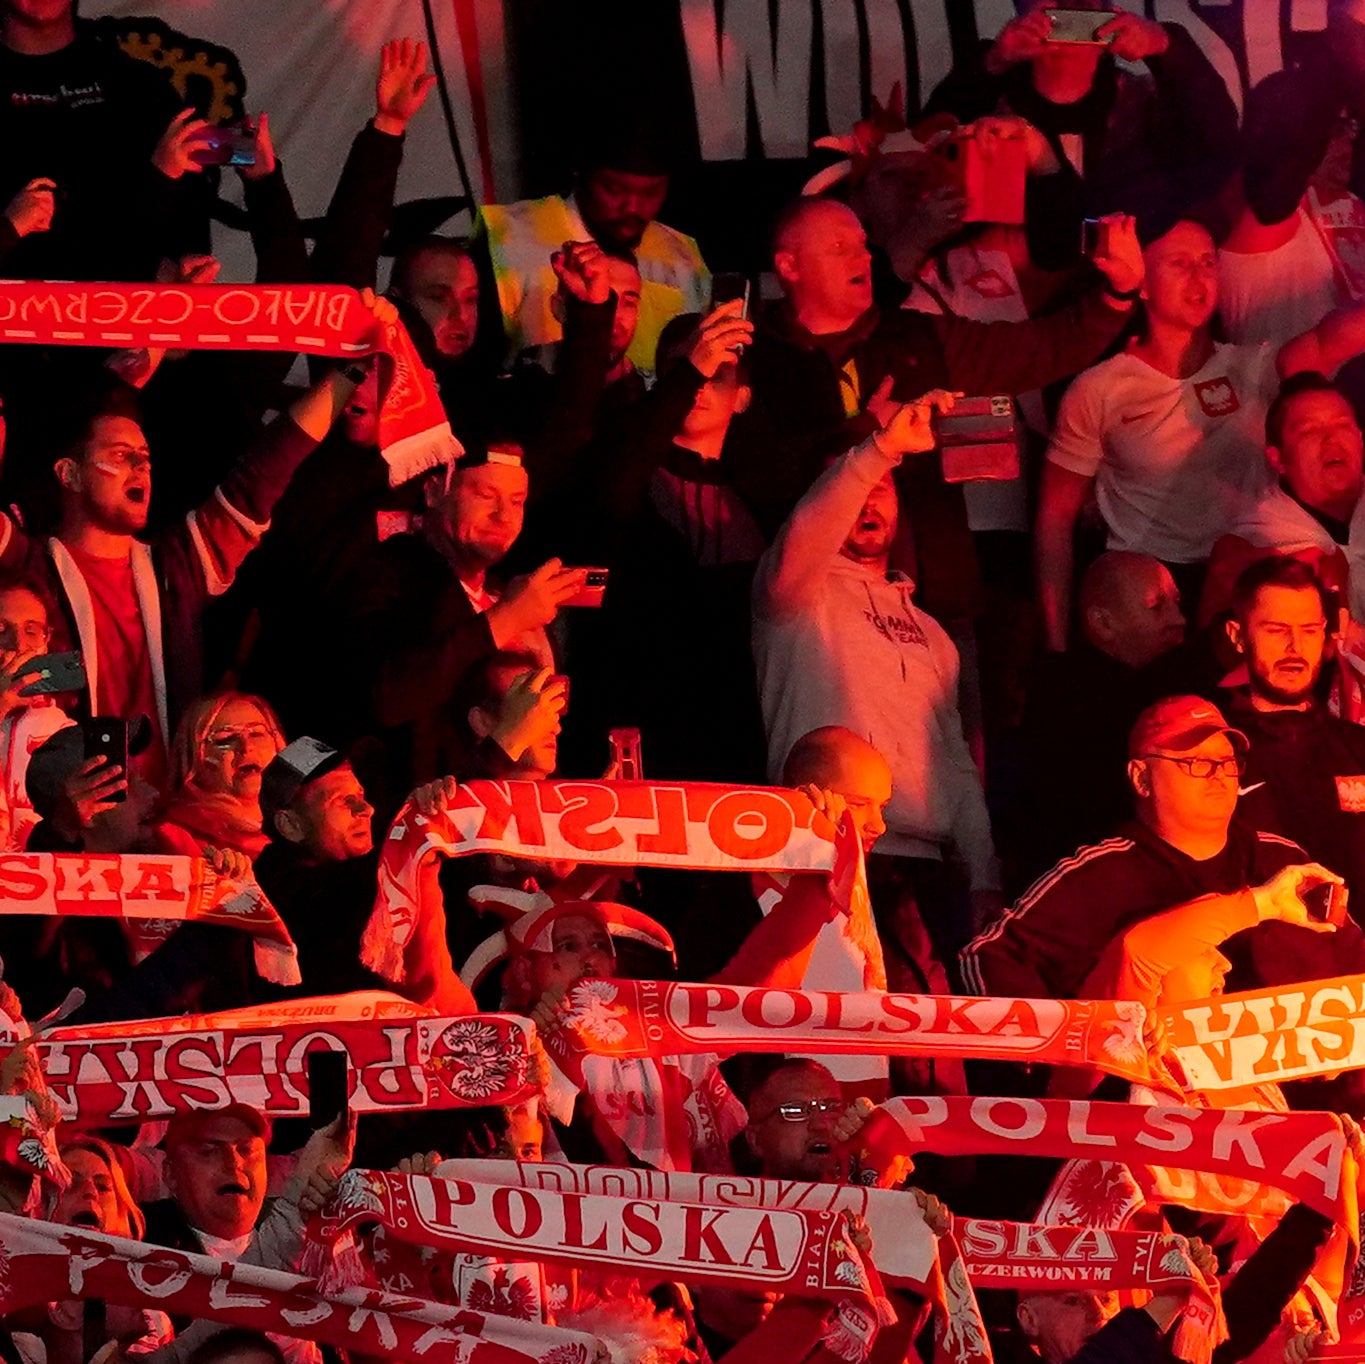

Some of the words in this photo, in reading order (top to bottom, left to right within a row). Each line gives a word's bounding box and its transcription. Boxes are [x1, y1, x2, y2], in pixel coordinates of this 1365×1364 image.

[0, 854, 186, 902] SKA
[641, 980, 662, 1043] BIAŁO
[681, 984, 1044, 1040] POLSKA
[888, 1097, 1345, 1201] POLSKA
[428, 1176, 783, 1271] POLSKA
[806, 1212, 831, 1289] BIAŁO
[963, 1221, 1117, 1262] SKA
[967, 1264, 1112, 1283] CZERWONYM
